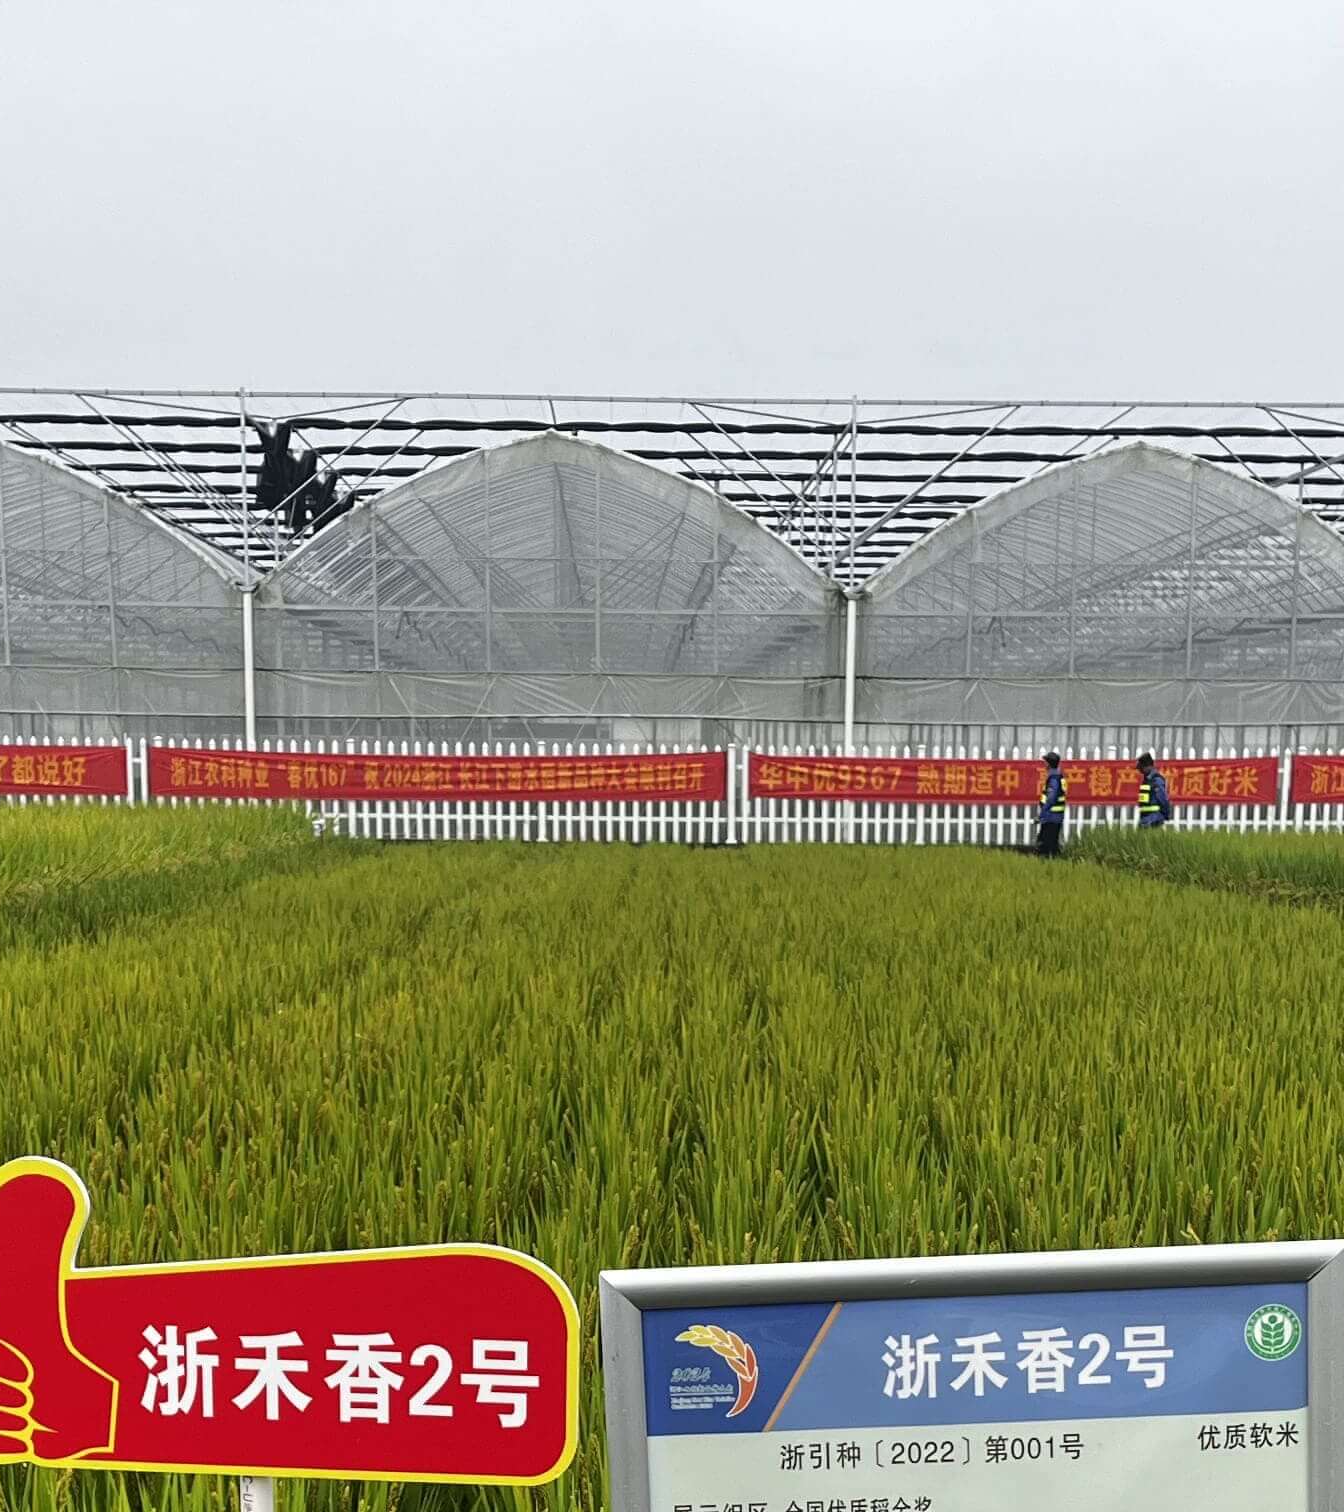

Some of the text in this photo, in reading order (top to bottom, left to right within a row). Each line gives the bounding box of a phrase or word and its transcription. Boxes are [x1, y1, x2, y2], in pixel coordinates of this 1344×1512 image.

[917, 764, 1020, 797] 熟期适中
[139, 1325, 540, 1428] 浙禾香2号
[882, 1325, 1174, 1400] 浙禾香2号
[1197, 1421, 1300, 1451] 优质软米
